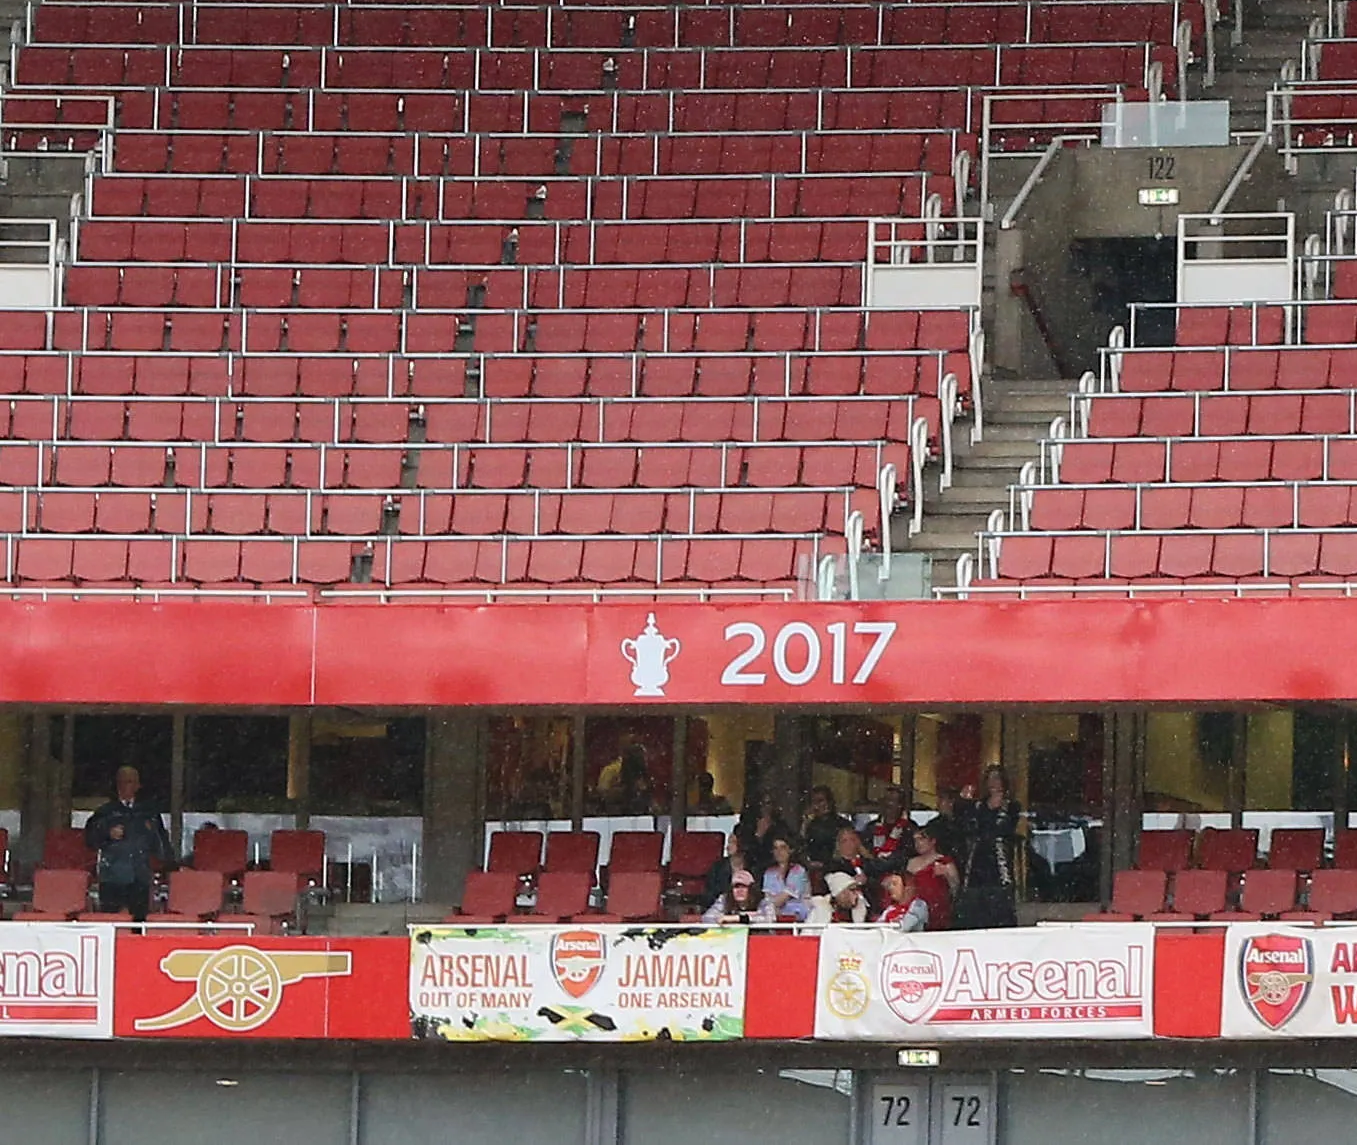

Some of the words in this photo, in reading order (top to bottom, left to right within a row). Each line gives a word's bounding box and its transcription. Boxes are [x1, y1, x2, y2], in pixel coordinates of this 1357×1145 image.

[1147, 156, 1175, 180] 122
[721, 621, 896, 687] 2017
[555, 938, 601, 952] Arsenal
[1247, 947, 1304, 965] Arsenal
[420, 953, 533, 988] ARSENAL
[618, 953, 733, 988] JAMAICA
[890, 962, 934, 975] Arsenal
[943, 944, 1144, 1003] Arsenal
[419, 992, 452, 1008] OUT
[457, 992, 478, 1008] OF
[481, 992, 532, 1009] MANY
[618, 991, 652, 1008] ONE
[657, 991, 733, 1008] ARSENAL
[970, 1007, 1030, 1020] ARMED
[1040, 1005, 1108, 1019] FORCES
[881, 1096, 910, 1127] 72
[951, 1096, 981, 1127] 72
